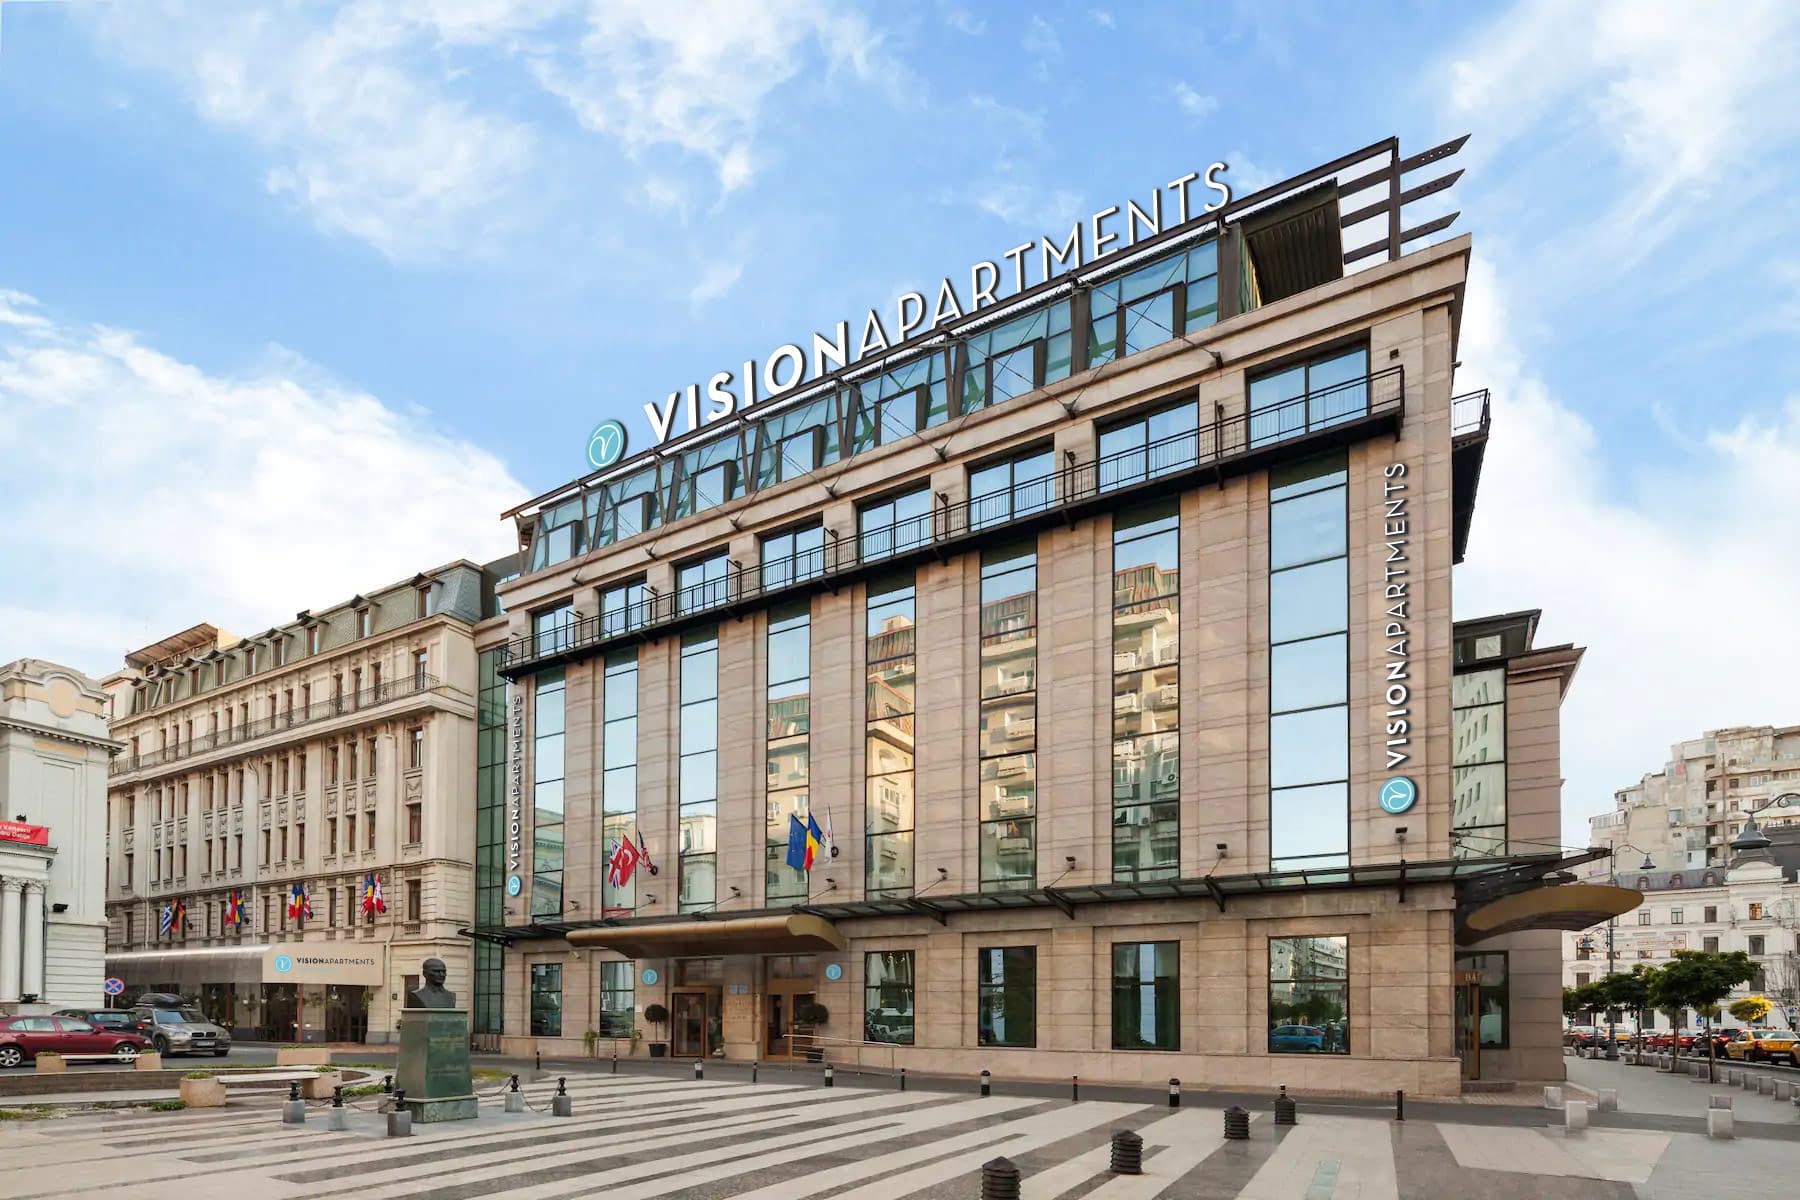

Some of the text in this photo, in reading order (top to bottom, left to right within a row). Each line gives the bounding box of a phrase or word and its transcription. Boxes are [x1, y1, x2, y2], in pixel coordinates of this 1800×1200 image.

[643, 161, 1231, 442] VISIONAPARTMENTS
[1384, 462, 1407, 769] VISIONAPARTMENTS
[511, 695, 521, 870] VISIONAPARTMENTS
[297, 957, 375, 965] VISIONAPARTMENTS
